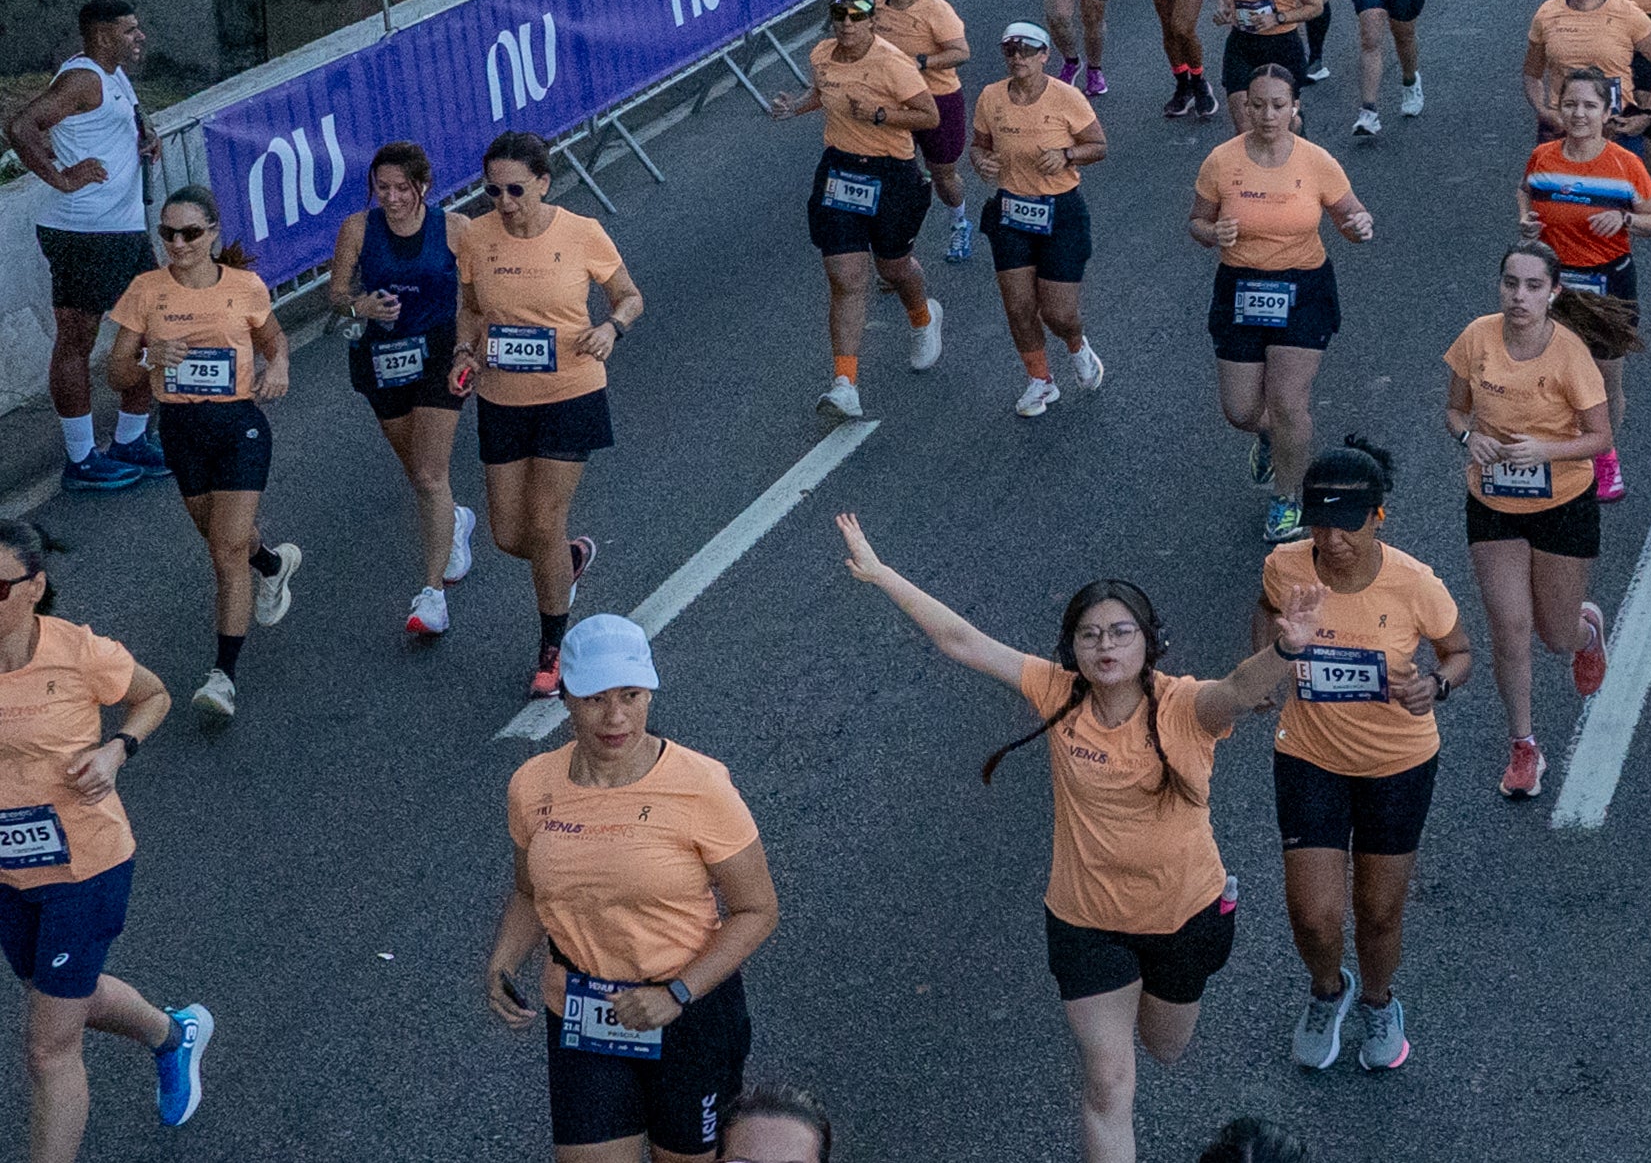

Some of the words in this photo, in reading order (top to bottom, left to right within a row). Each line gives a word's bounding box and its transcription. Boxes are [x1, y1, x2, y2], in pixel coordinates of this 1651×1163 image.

[486, 12, 556, 123] nu
[247, 114, 346, 243] nu
[843, 184, 869, 199] 1991
[1014, 203, 1046, 219] 2059
[1248, 295, 1286, 310] 2509
[504, 341, 545, 357] 2408
[385, 353, 418, 371] 2374
[189, 363, 219, 379] 785
[1322, 667, 1371, 683] 1975
[0, 825, 51, 846] 2015
[568, 998, 580, 1018] D
[594, 1006, 620, 1027] 18
